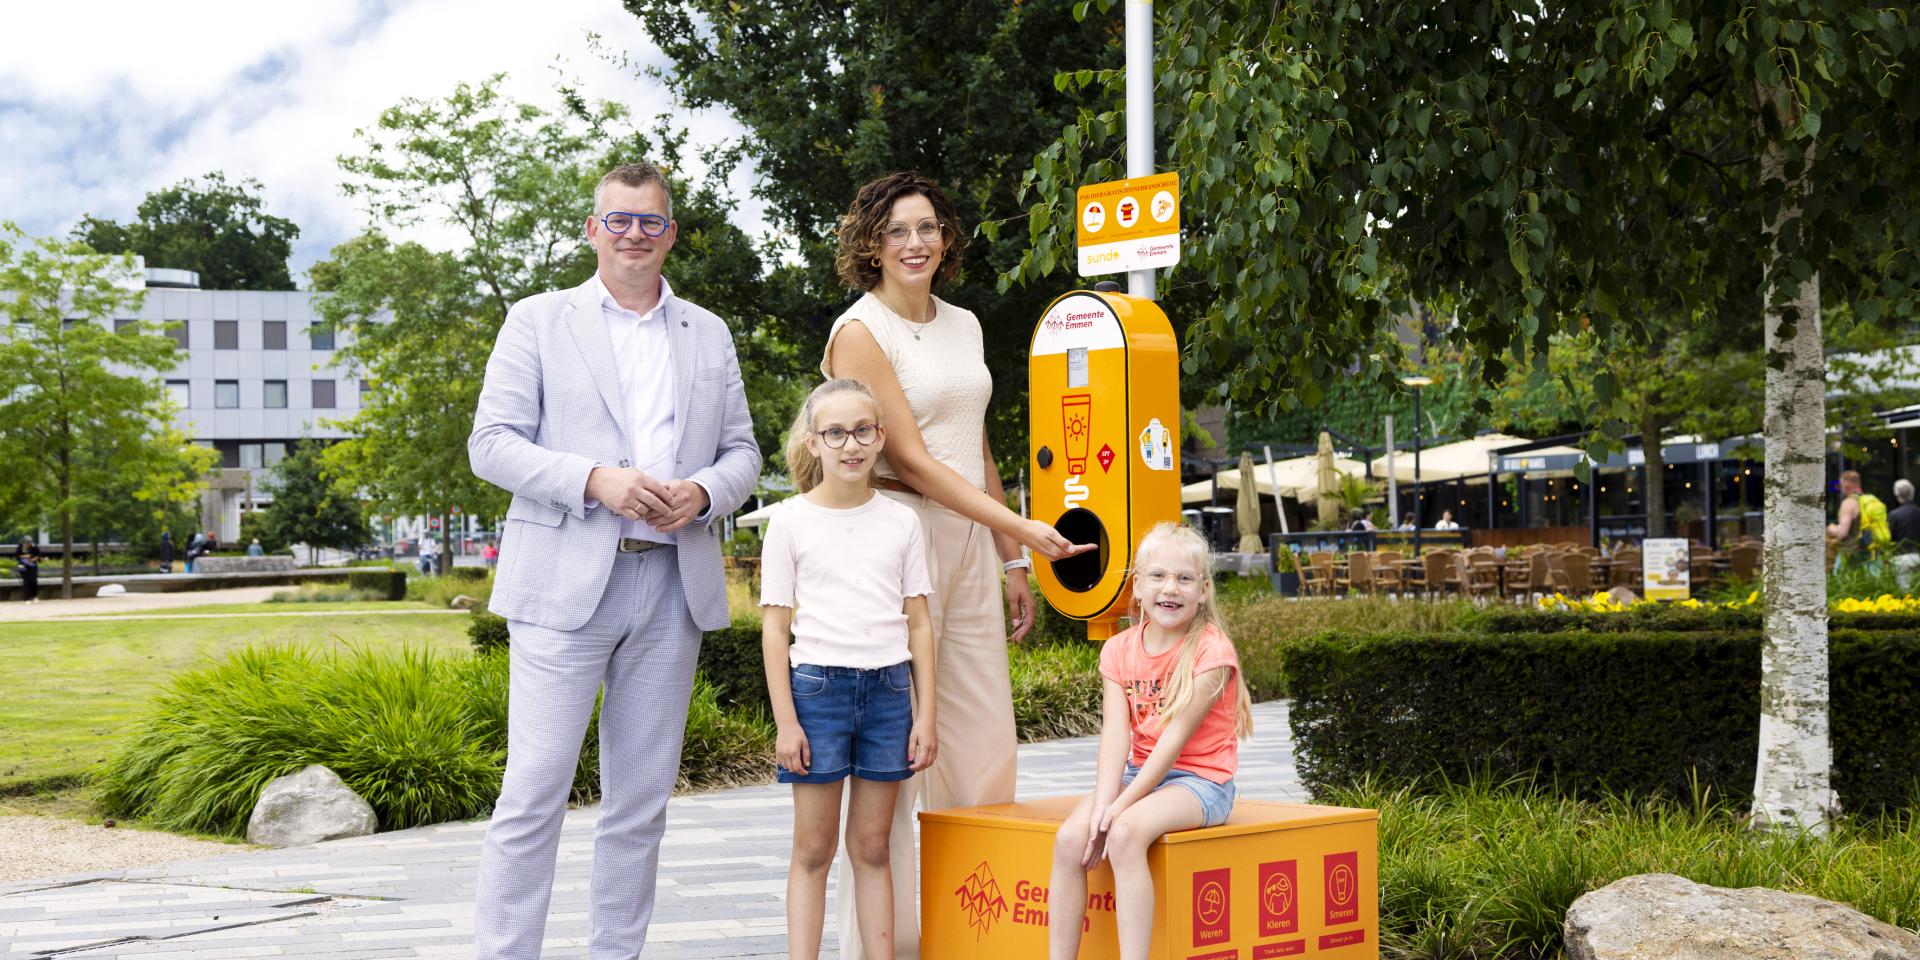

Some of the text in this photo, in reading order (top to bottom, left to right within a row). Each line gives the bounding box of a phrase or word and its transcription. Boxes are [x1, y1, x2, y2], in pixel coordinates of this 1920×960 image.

[1066, 310, 1105, 321] Gemeente
[1065, 321, 1093, 330] Emmen
[1329, 908, 1354, 920] Smeren
[1266, 919, 1291, 930] Kleren
[1200, 929, 1223, 940] Weren
